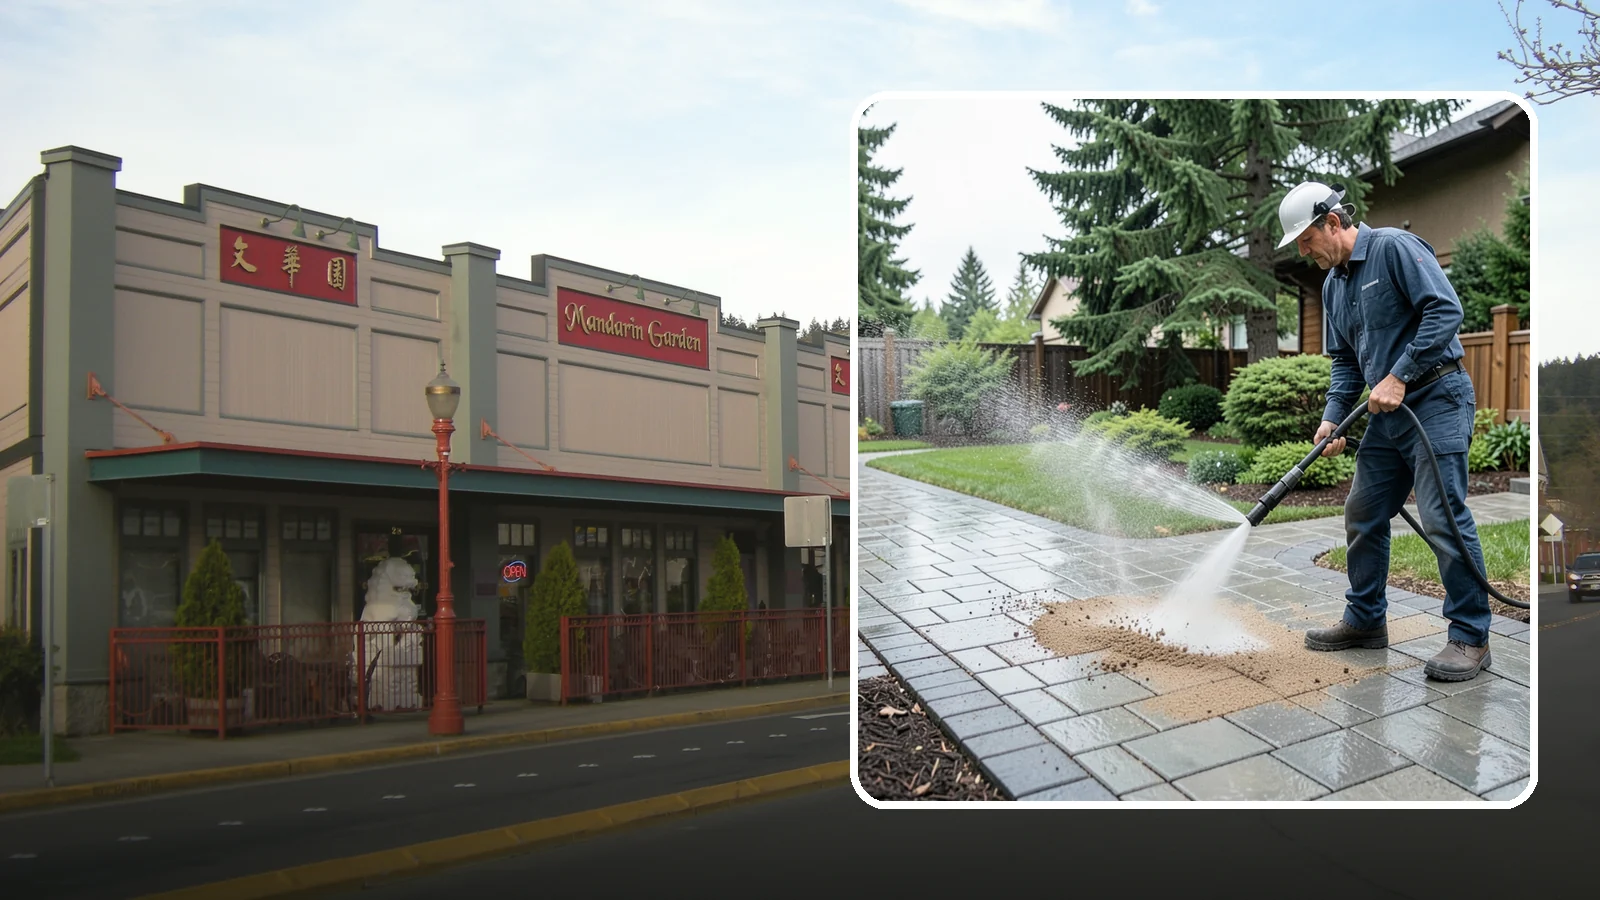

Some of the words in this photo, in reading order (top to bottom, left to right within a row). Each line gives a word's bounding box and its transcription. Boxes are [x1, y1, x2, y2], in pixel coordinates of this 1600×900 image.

[230, 235, 346, 291] 文華園
[564, 302, 644, 341] Mandarin
[648, 320, 701, 352] Garden
[503, 565, 527, 578] OPEN
